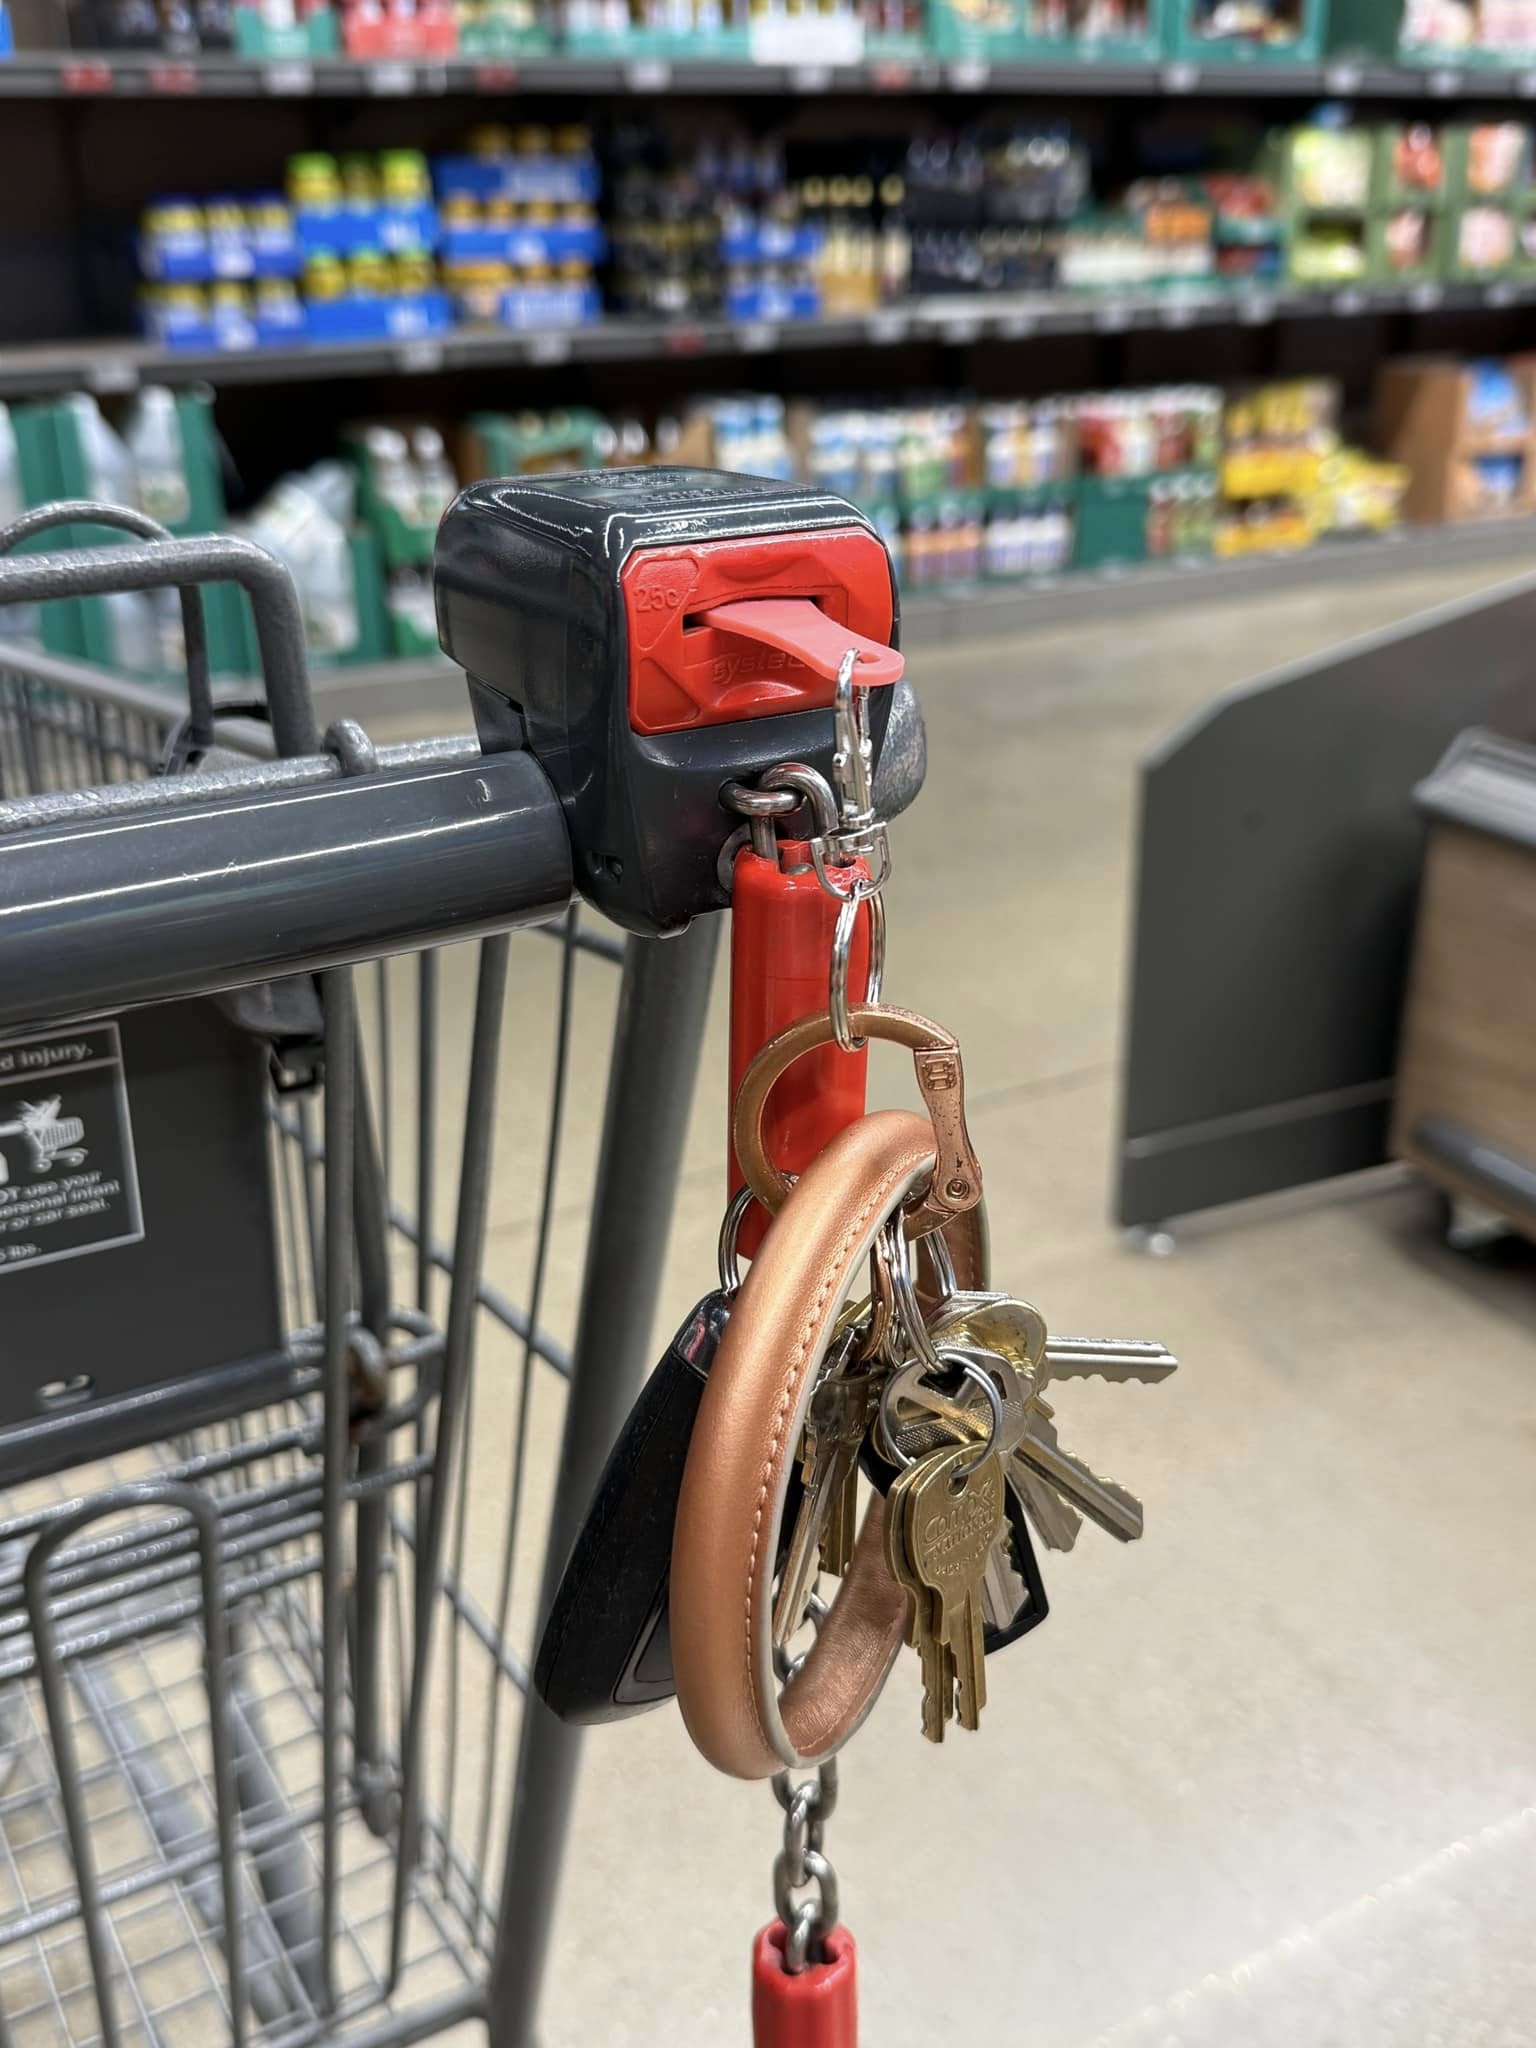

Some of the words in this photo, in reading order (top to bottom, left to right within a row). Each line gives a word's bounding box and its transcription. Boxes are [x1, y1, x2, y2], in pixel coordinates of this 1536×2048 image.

[22, 1181, 58, 1199] use
[60, 1171, 101, 1191] your
[69, 1179, 119, 1201] infant
[31, 1208, 63, 1226] car
[63, 1198, 110, 1219] seat.
